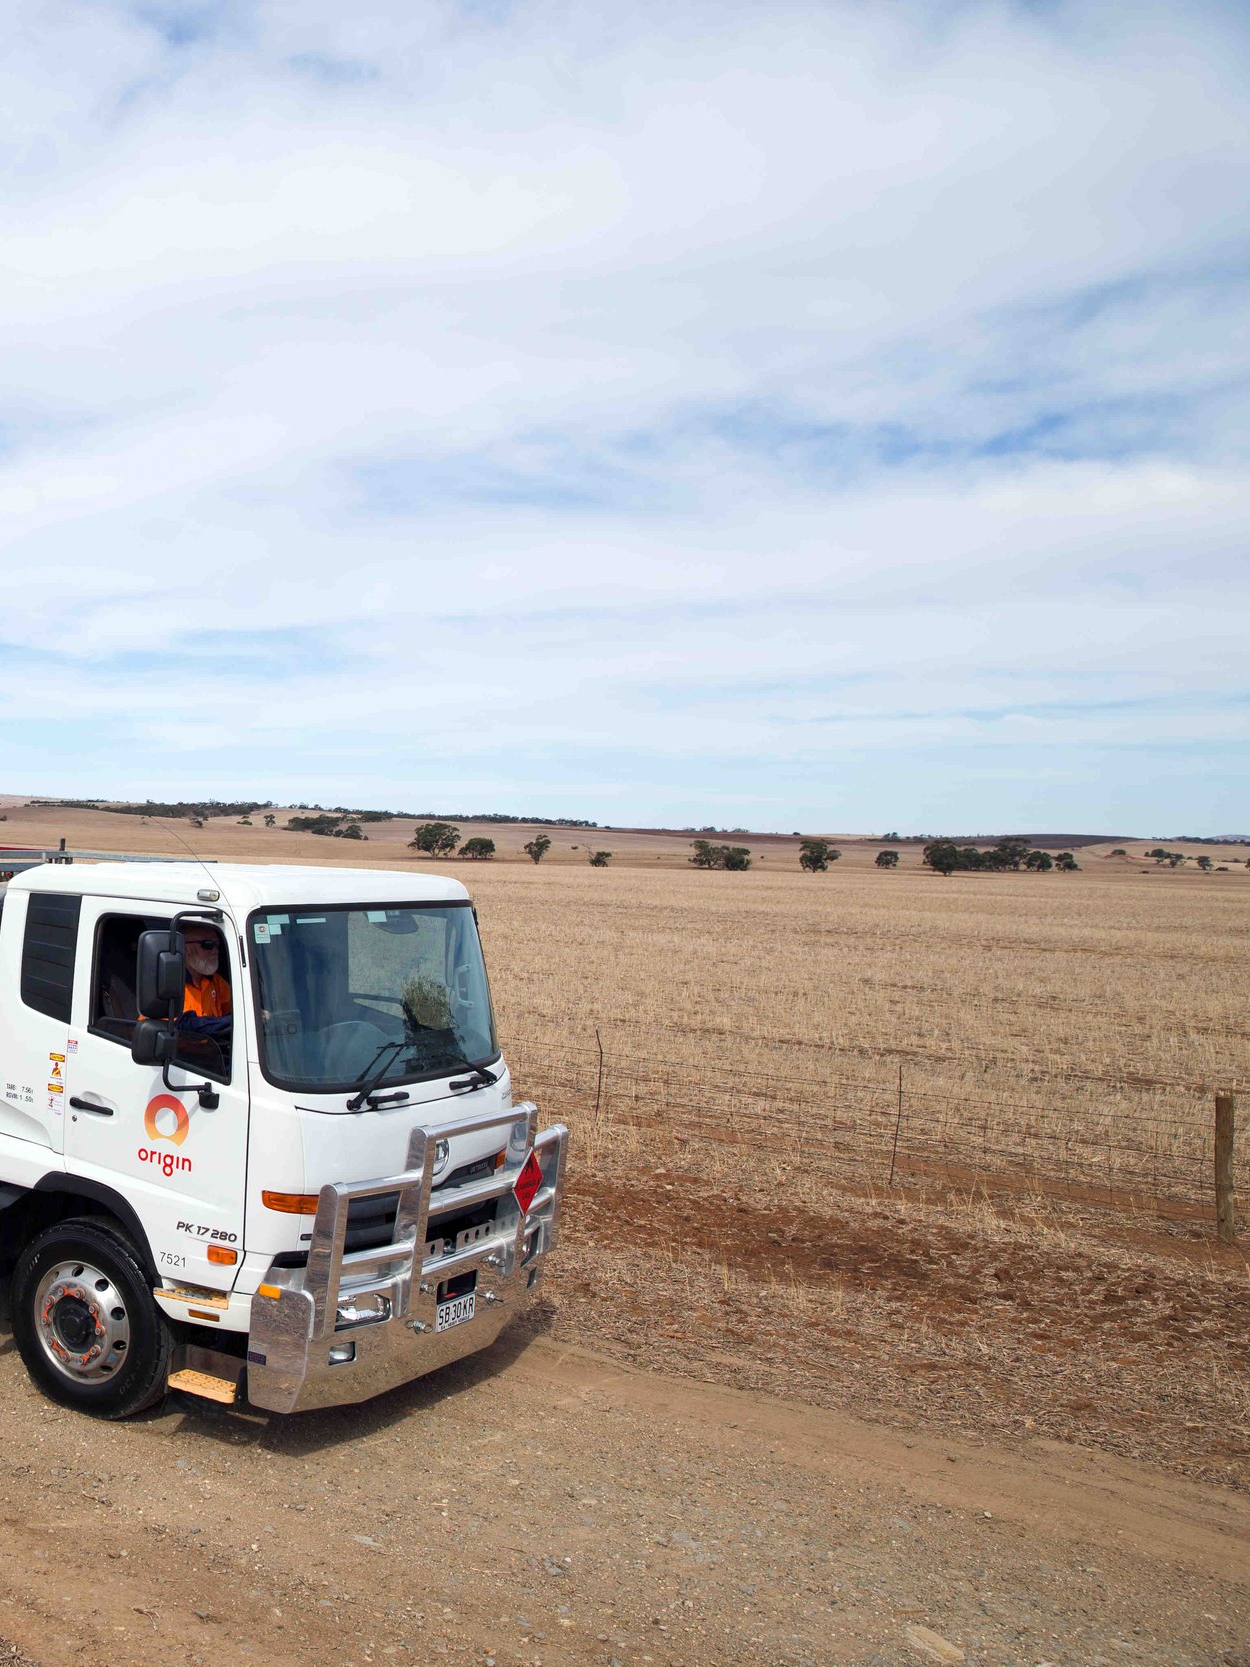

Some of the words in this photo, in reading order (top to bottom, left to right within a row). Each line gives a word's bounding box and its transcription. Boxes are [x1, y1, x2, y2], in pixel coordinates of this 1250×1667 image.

[137, 1148, 192, 1177] origin
[176, 1221, 195, 1234] PK
[196, 1225, 210, 1236] 17
[210, 1229, 238, 1243] 280
[160, 1251, 187, 1268] 7521
